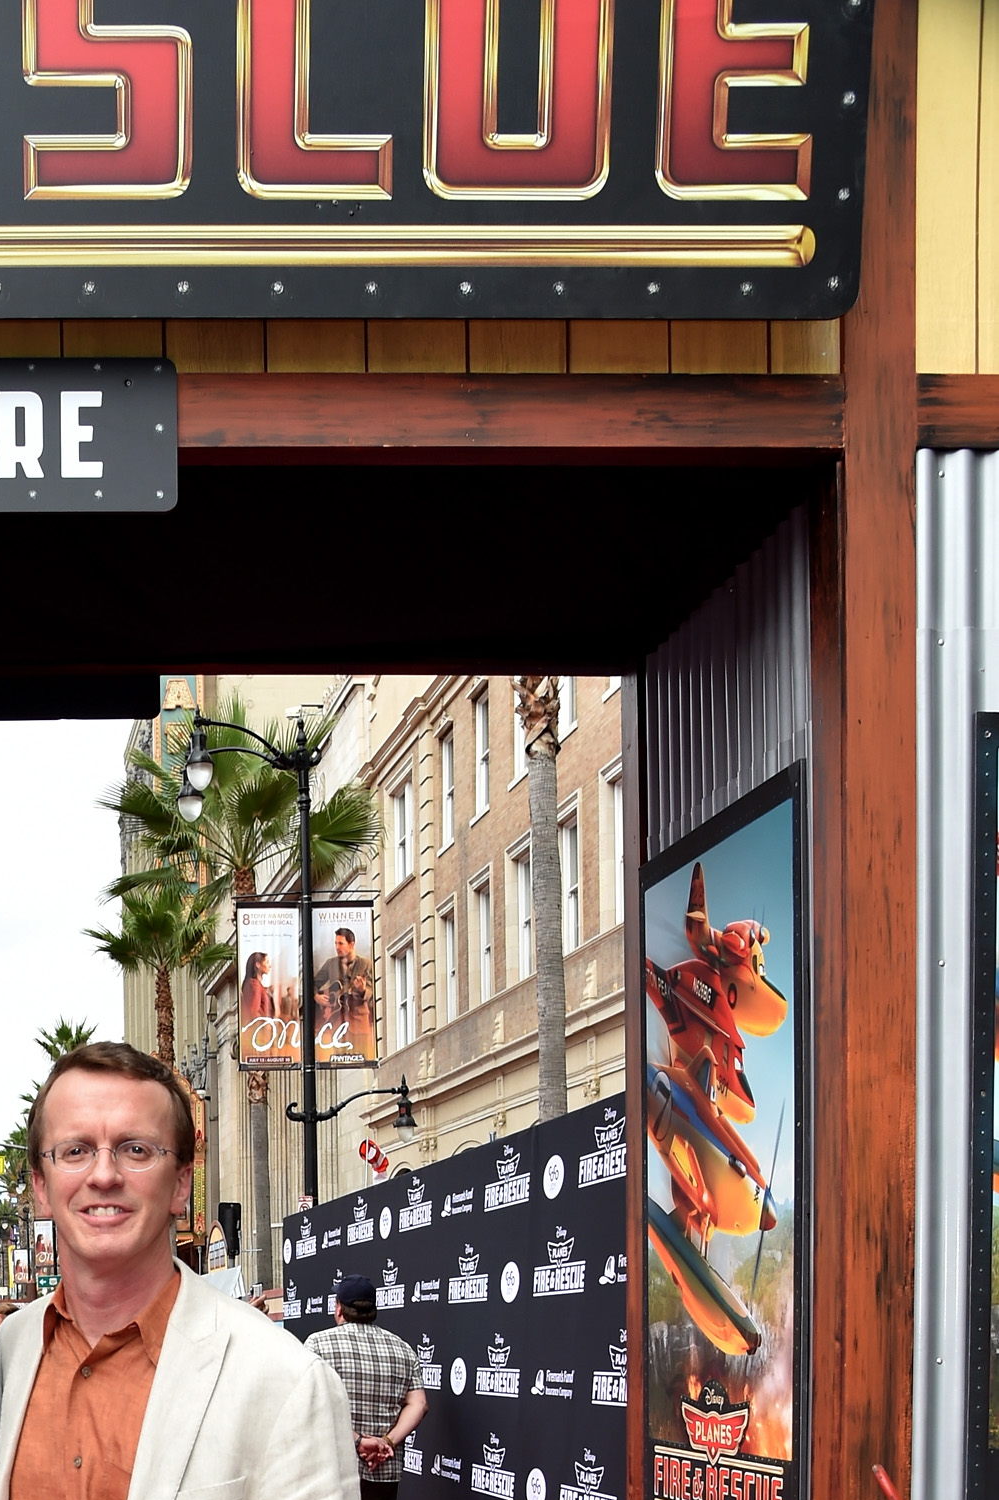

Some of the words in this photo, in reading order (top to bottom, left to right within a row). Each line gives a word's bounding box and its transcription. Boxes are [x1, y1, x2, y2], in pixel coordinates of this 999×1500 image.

[599, 1127, 618, 1143] PLANES
[552, 1246, 568, 1259] PLANES
[695, 1420, 732, 1446] PLANES
[579, 1470, 597, 1485] PLANES
